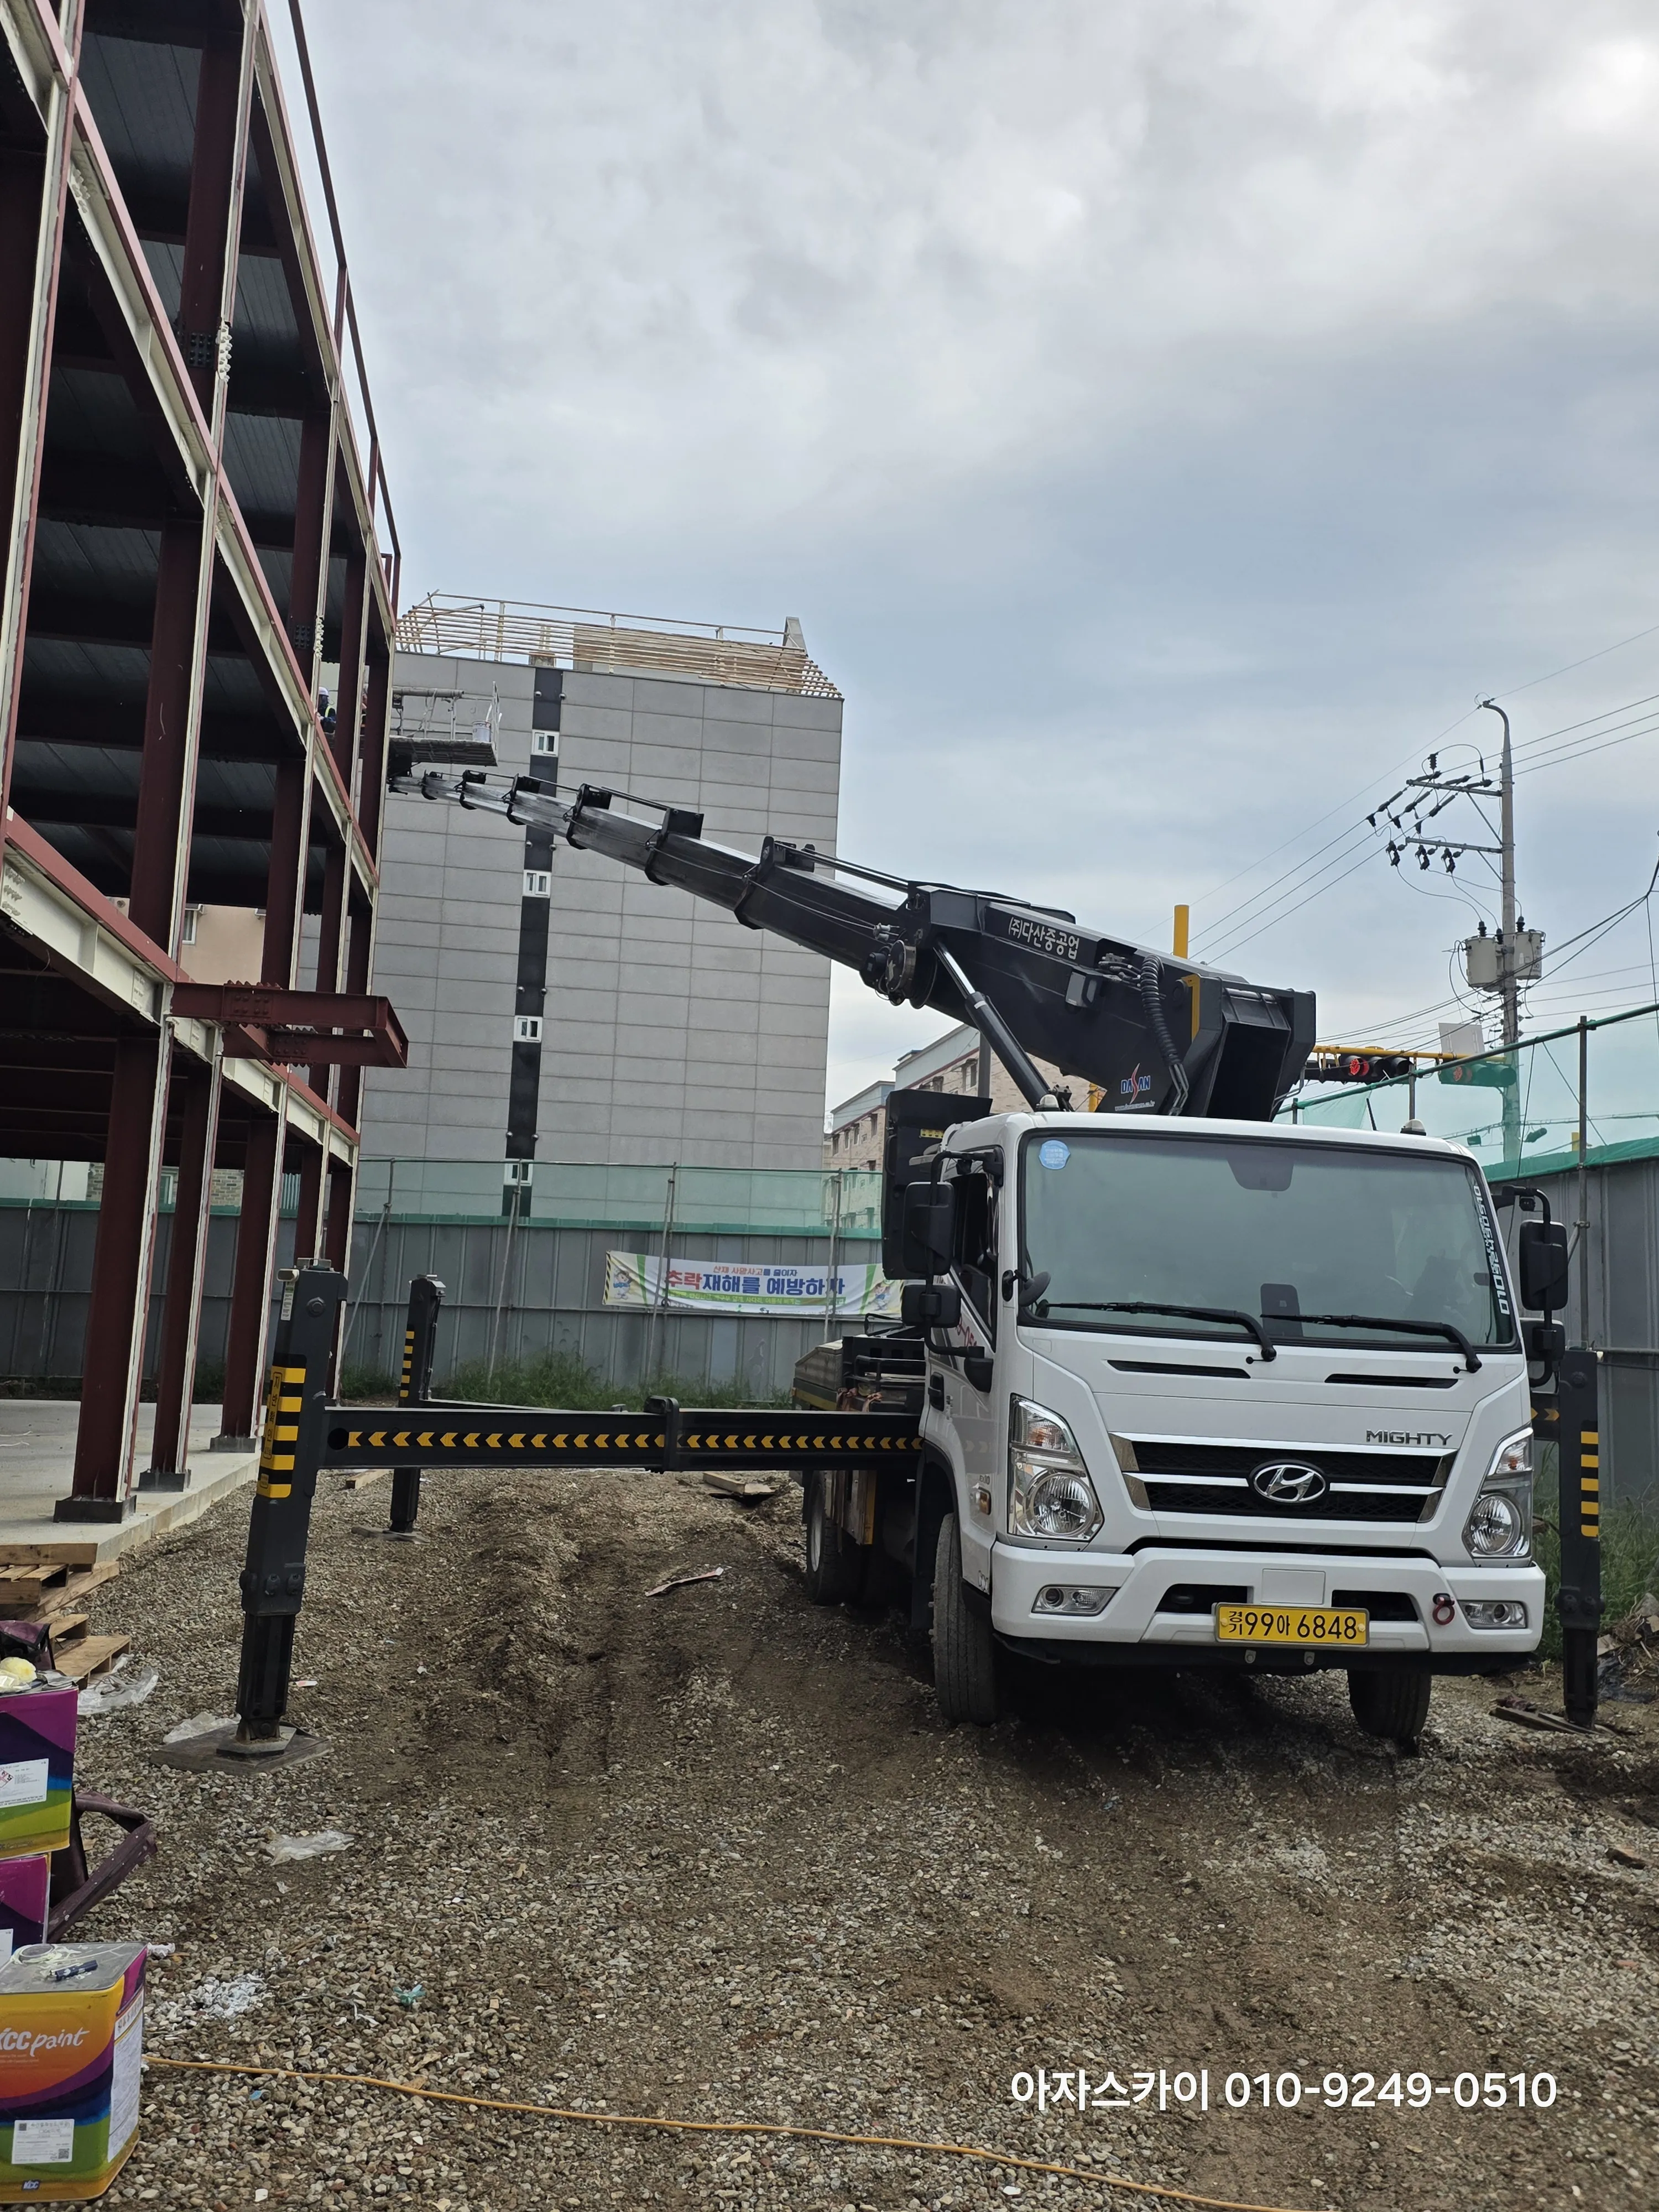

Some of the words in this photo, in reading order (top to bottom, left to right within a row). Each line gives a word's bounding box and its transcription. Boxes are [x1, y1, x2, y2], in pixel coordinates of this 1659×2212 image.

[1009, 917, 1079, 959] (주)다산중공업
[664, 1270, 760, 1294] 추락재해를
[766, 1277, 845, 1295] 예방하자
[713, 1265, 729, 1274] 산재
[732, 1267, 771, 1276] 사망사고를
[1366, 1430, 1453, 1446] MIGHTY
[1229, 1611, 1243, 1635] 경기
[1245, 1612, 1290, 1636] 99아
[1297, 1614, 1357, 1640] 6848
[30, 2027, 90, 2057] paint
